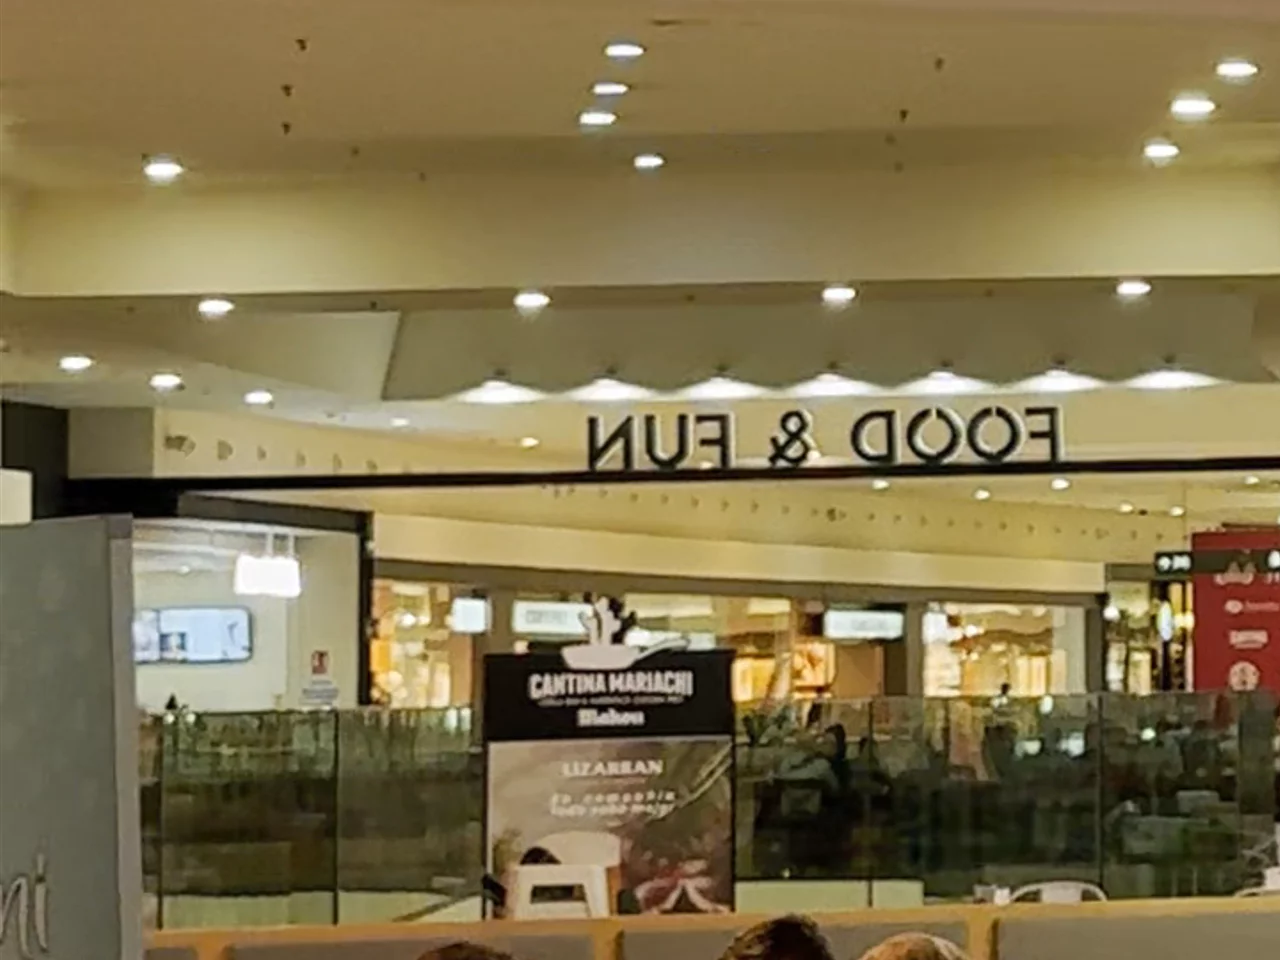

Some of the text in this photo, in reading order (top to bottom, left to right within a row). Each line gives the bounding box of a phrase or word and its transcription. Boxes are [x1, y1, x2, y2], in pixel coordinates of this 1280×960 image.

[528, 670, 694, 699] CANTINA MARIACHI
[561, 759, 664, 778] LIZARRAN
